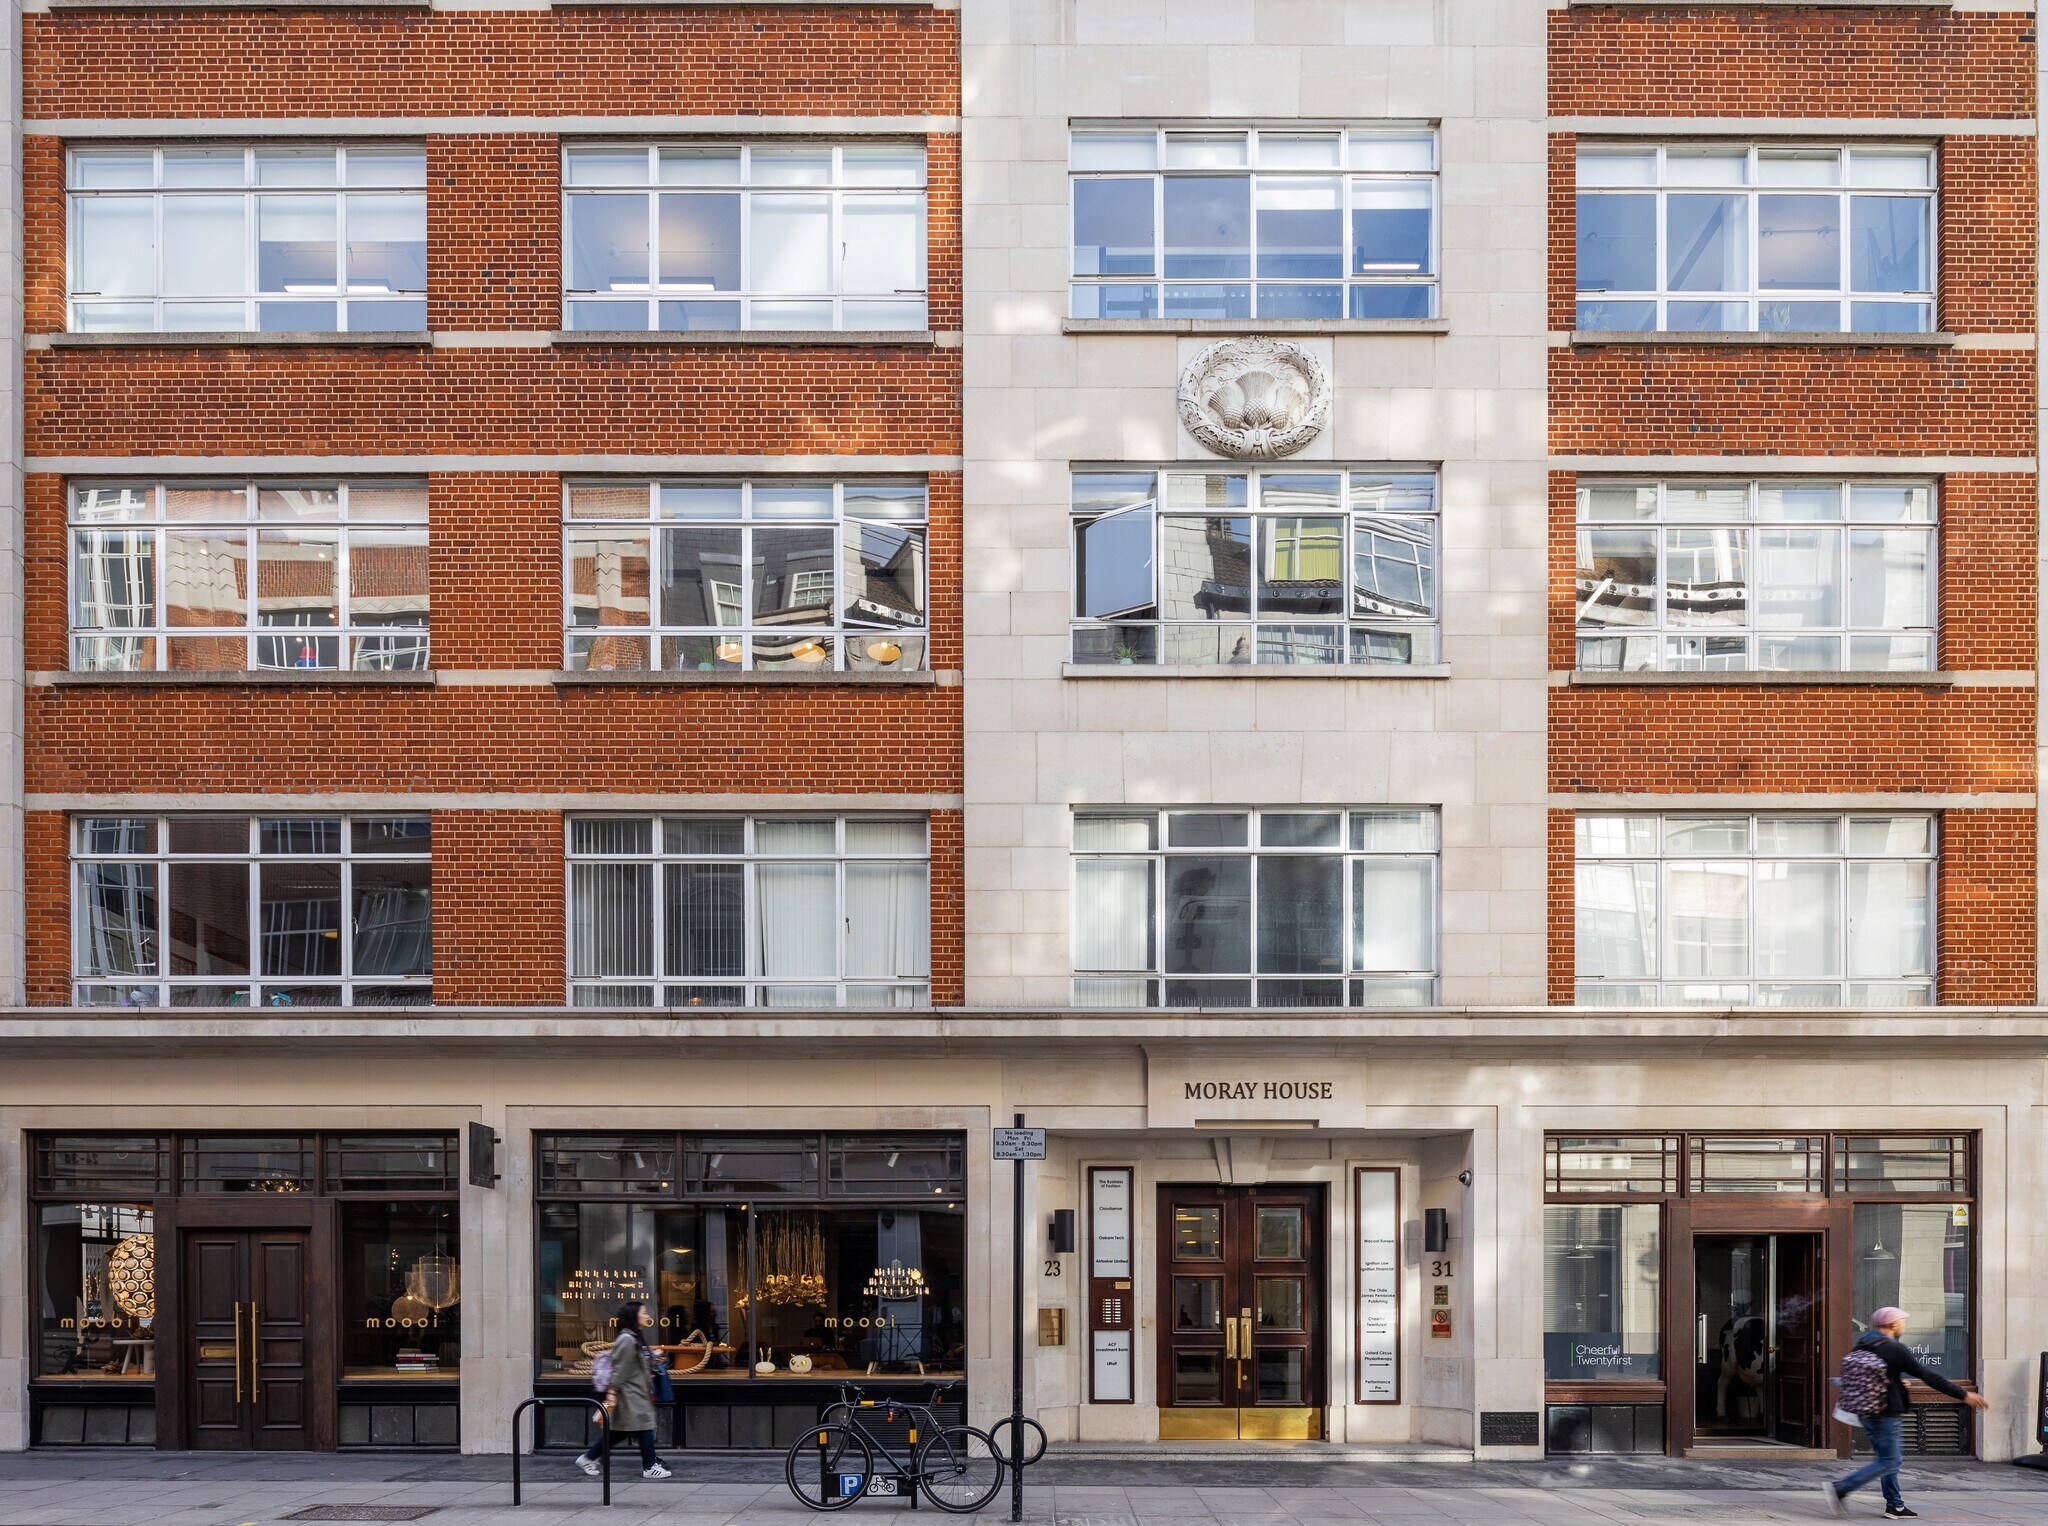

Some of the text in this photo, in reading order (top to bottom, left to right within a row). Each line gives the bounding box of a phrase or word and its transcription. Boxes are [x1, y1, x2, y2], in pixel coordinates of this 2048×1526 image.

[1184, 1082, 1333, 1099] MORAY HOUSE
[1044, 1260, 1061, 1276] 23
[1432, 1261, 1453, 1277] 31
[60, 1316, 131, 1328] moooi
[366, 1314, 438, 1328] moooi
[609, 1314, 680, 1328] mooi
[824, 1314, 895, 1328] moooi
[1576, 1344, 1620, 1355] Cheerful
[1907, 1344, 1930, 1354] erful
[1576, 1355, 1632, 1367] Twentyfirst
[844, 1476, 858, 1494] P
